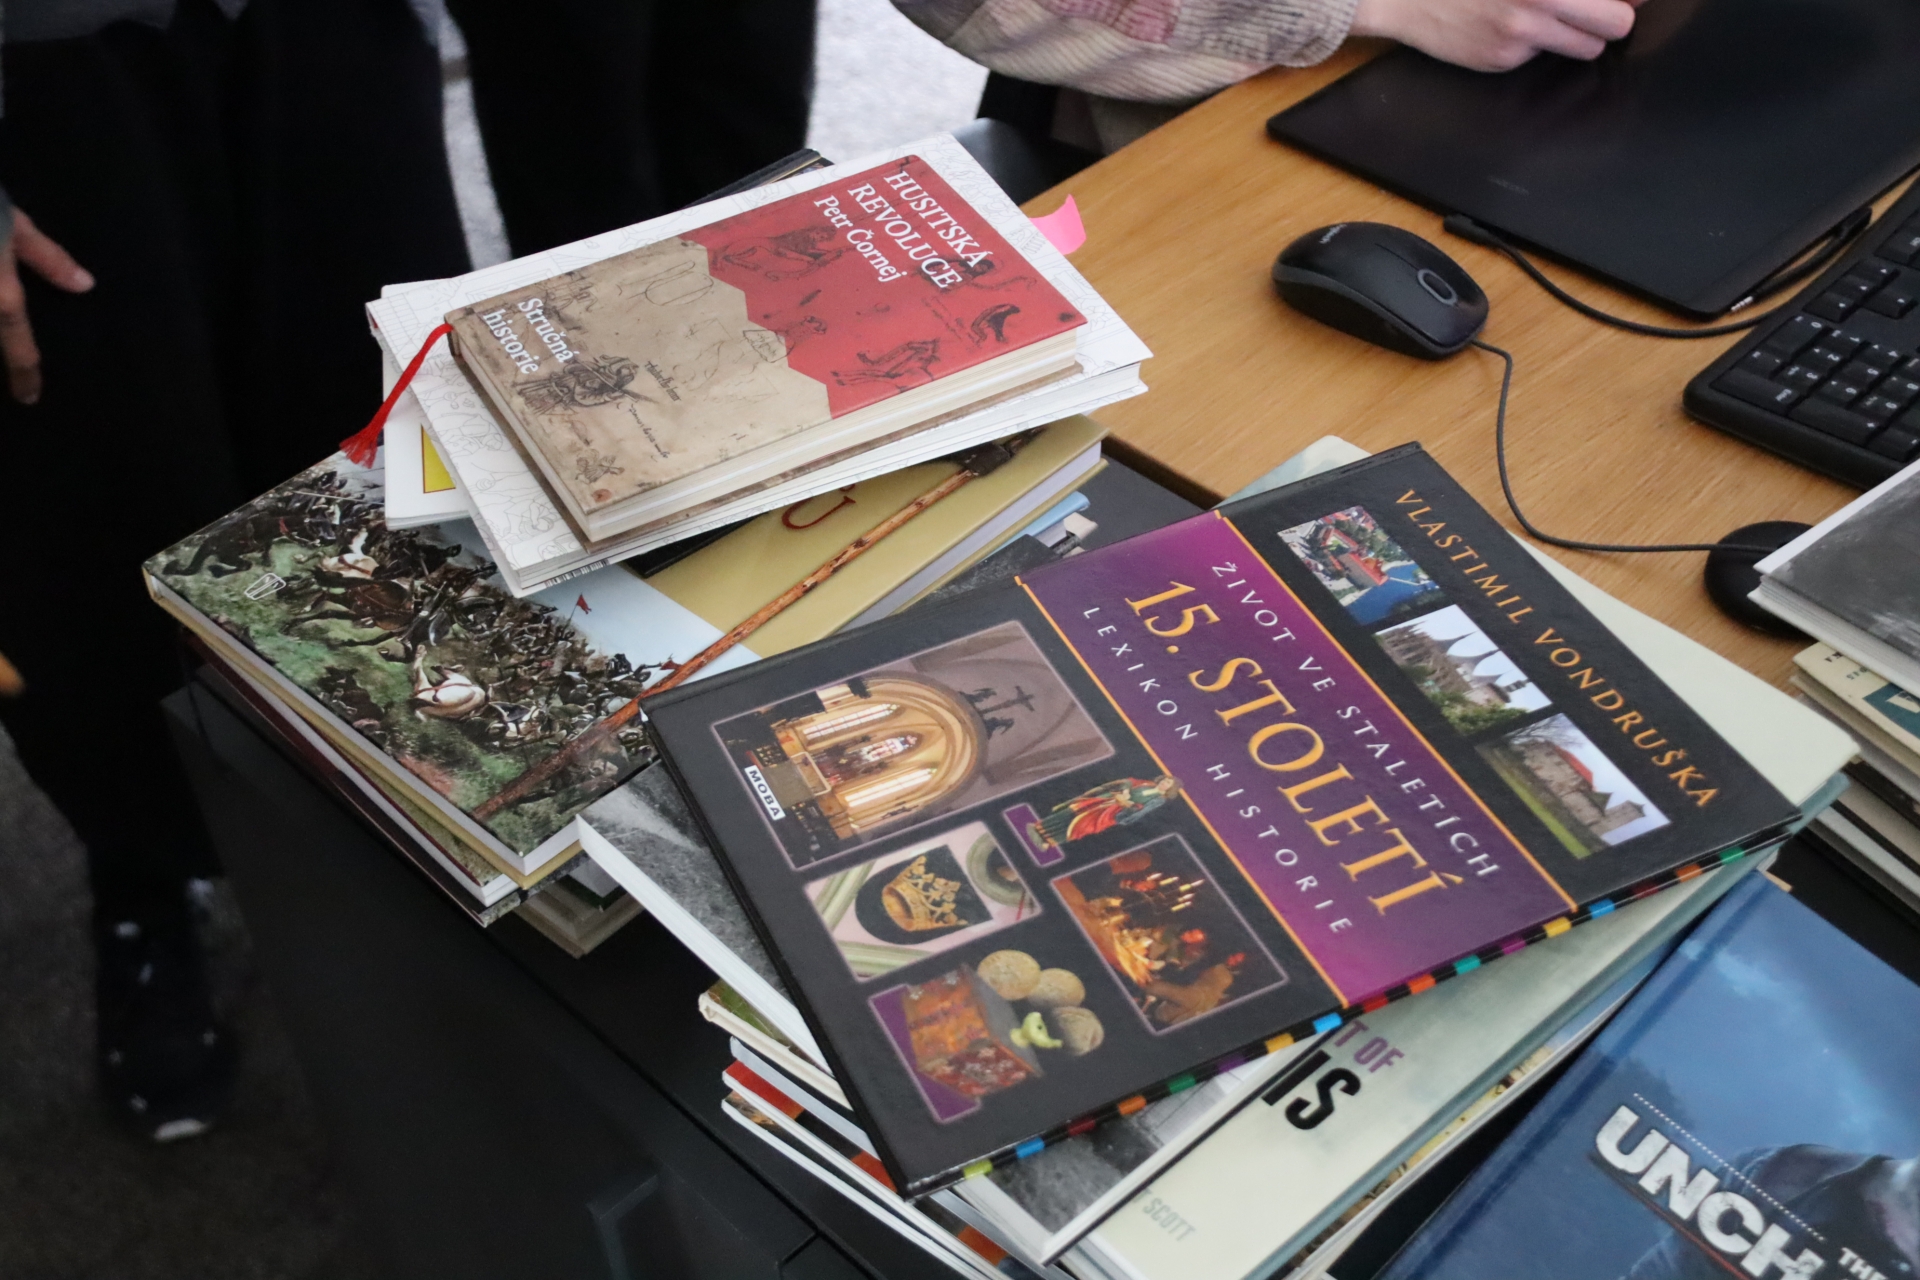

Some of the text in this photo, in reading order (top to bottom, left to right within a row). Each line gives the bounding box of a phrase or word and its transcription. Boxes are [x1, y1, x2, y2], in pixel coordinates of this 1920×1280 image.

[814, 195, 907, 282] Petr Čornej
[847, 183, 963, 288] REVOLUCE
[884, 171, 993, 267] HUSITSKÁ
[483, 308, 539, 375] historie
[518, 297, 579, 363] Stručná
[1395, 488, 1719, 807] VLASTIMIL VONDRUŠKA
[1124, 581, 1465, 916] 15. STOLETÍ
[1211, 561, 1500, 876] ŽIVOT VE STALETÍCH
[749, 769, 781, 817] MOBA
[1083, 607, 1353, 933] LEXIKON HISTORIE
[1353, 1036, 1405, 1073] OF
[1142, 1197, 1196, 1242] SCOTT
